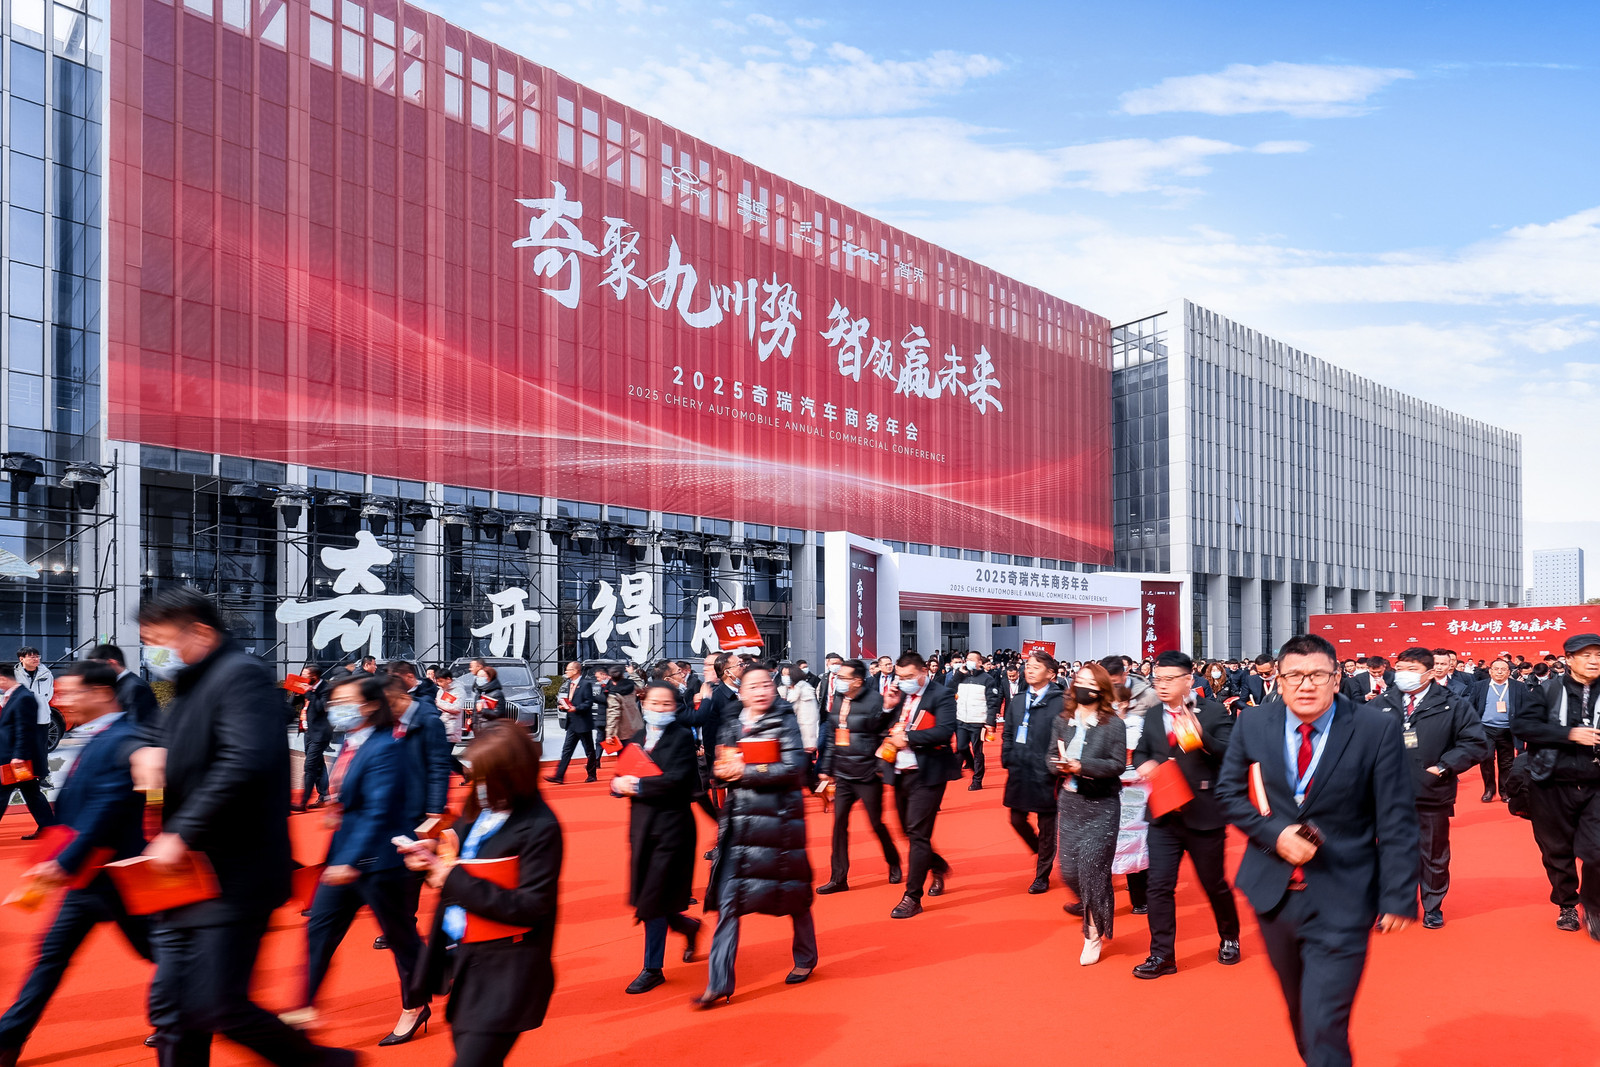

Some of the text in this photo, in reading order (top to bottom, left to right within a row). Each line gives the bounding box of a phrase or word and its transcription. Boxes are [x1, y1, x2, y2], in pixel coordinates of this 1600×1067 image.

[661, 176, 709, 200] CHERY
[899, 260, 925, 285] 智界
[512, 180, 1003, 415] 奇聚九州势 智领赢未来
[672, 365, 919, 442] 2025奇瑞汽车商务年会
[628, 384, 946, 463] 2025 CHERY AUTOMOBILE ANNUAL COMMERCIAL CONFERENCE
[975, 568, 1090, 592] 2025奇瑞汽车商务年会
[950, 584, 1109, 603] 2025 CHERY AUTOMOBILE ANNUAL COMMERCIAL CONFERENCE
[726, 623, 747, 637] B组
